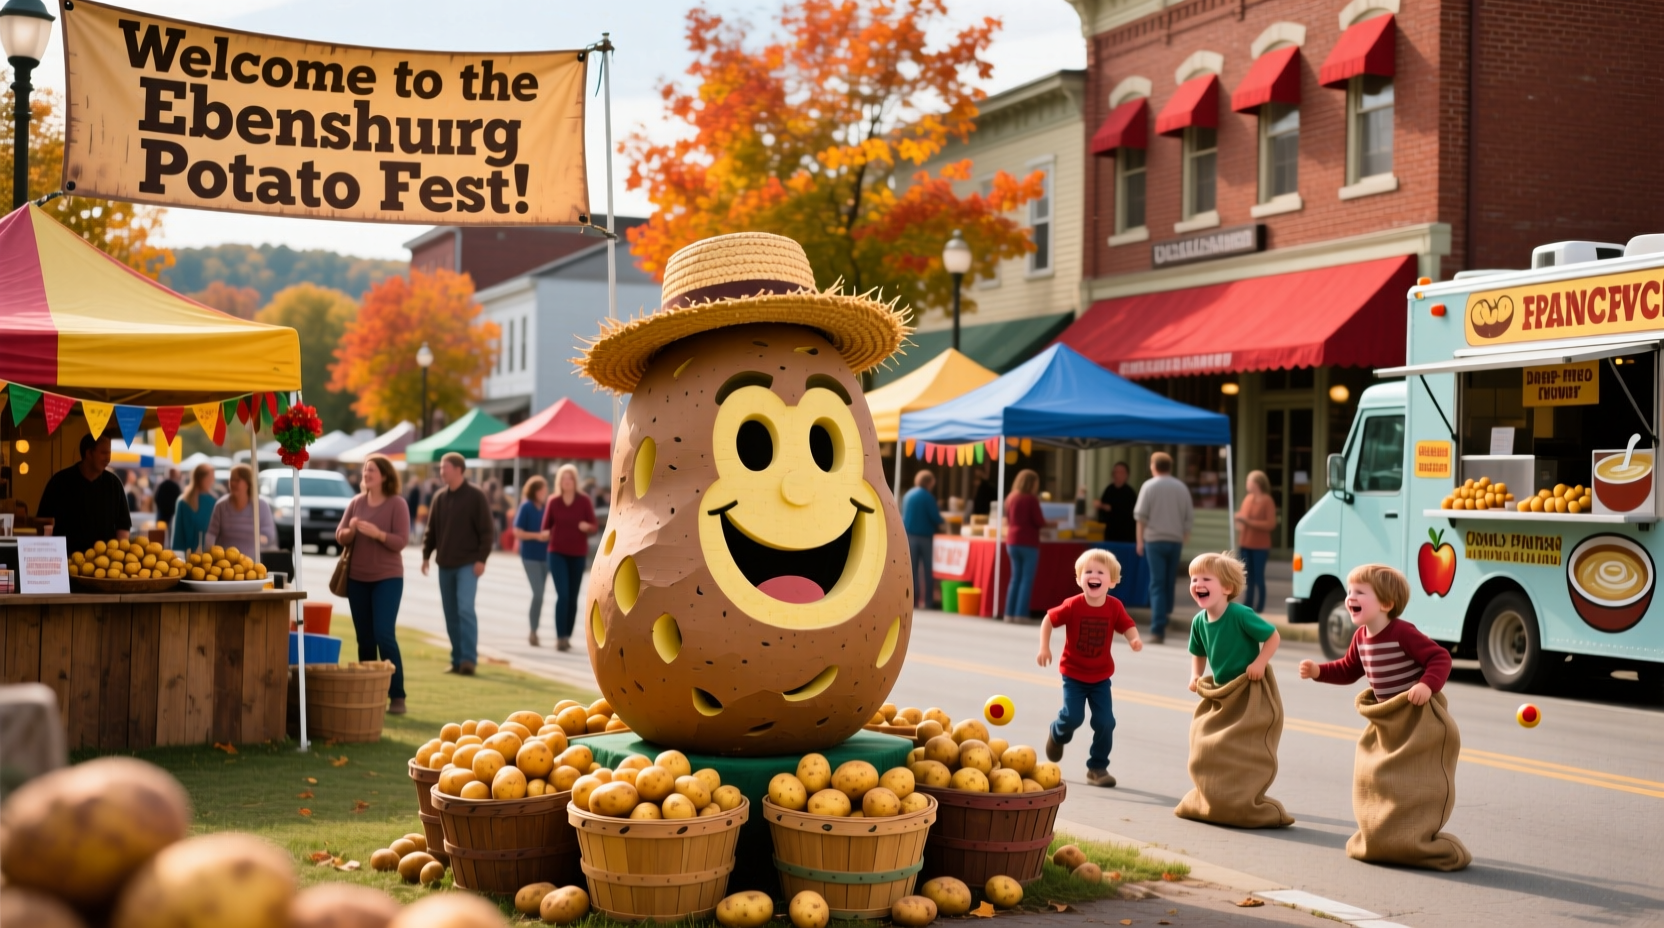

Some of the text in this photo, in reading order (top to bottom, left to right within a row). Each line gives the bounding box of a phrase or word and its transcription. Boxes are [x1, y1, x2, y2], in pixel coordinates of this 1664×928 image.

[118, 18, 538, 102] Welcome to the
[138, 137, 530, 215] Potato Fest!
